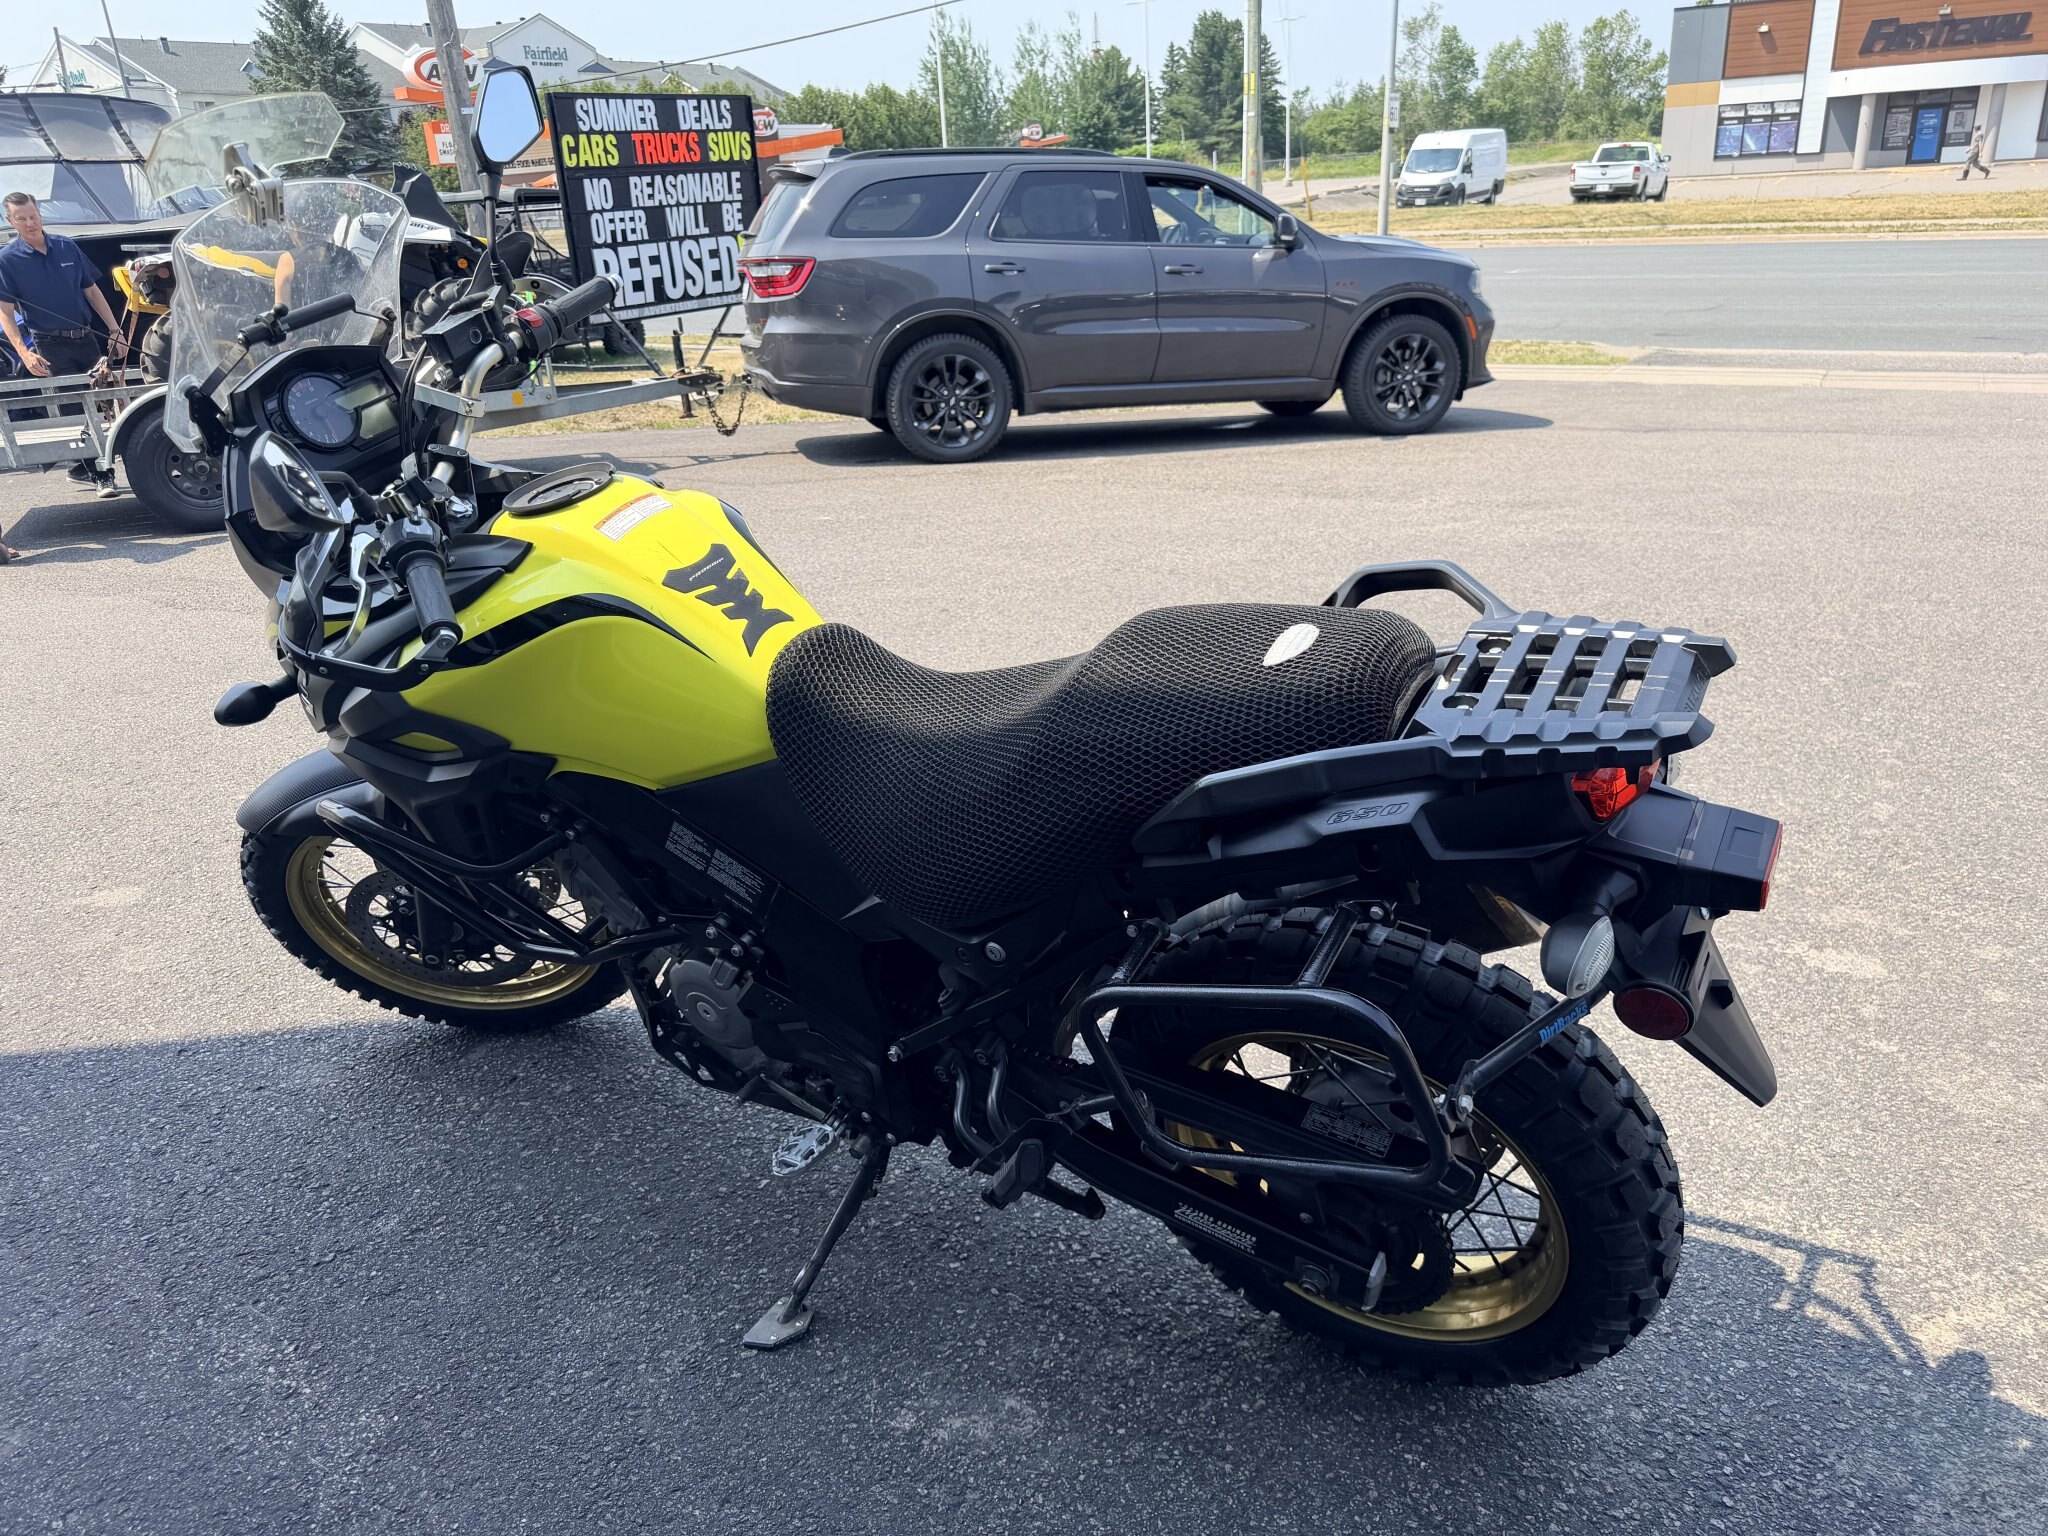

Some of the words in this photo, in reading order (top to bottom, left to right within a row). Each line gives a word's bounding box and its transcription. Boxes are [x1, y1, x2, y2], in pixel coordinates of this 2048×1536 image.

[523, 45, 568, 60] Fairfield
[575, 98, 659, 132] SUMMER
[676, 99, 733, 131] DEALS
[1389, 106, 1398, 122] 60
[561, 134, 619, 168] CARS
[631, 132, 701, 165] TRUCKS
[707, 131, 752, 162] SUVS
[583, 178, 613, 211] NO
[629, 171, 743, 208] REASONABLE
[590, 209, 649, 244] OFFER
[665, 205, 709, 237] WILL
[721, 202, 744, 232] BE
[592, 235, 741, 309] REFUSED
[1326, 802, 1409, 825] 650
